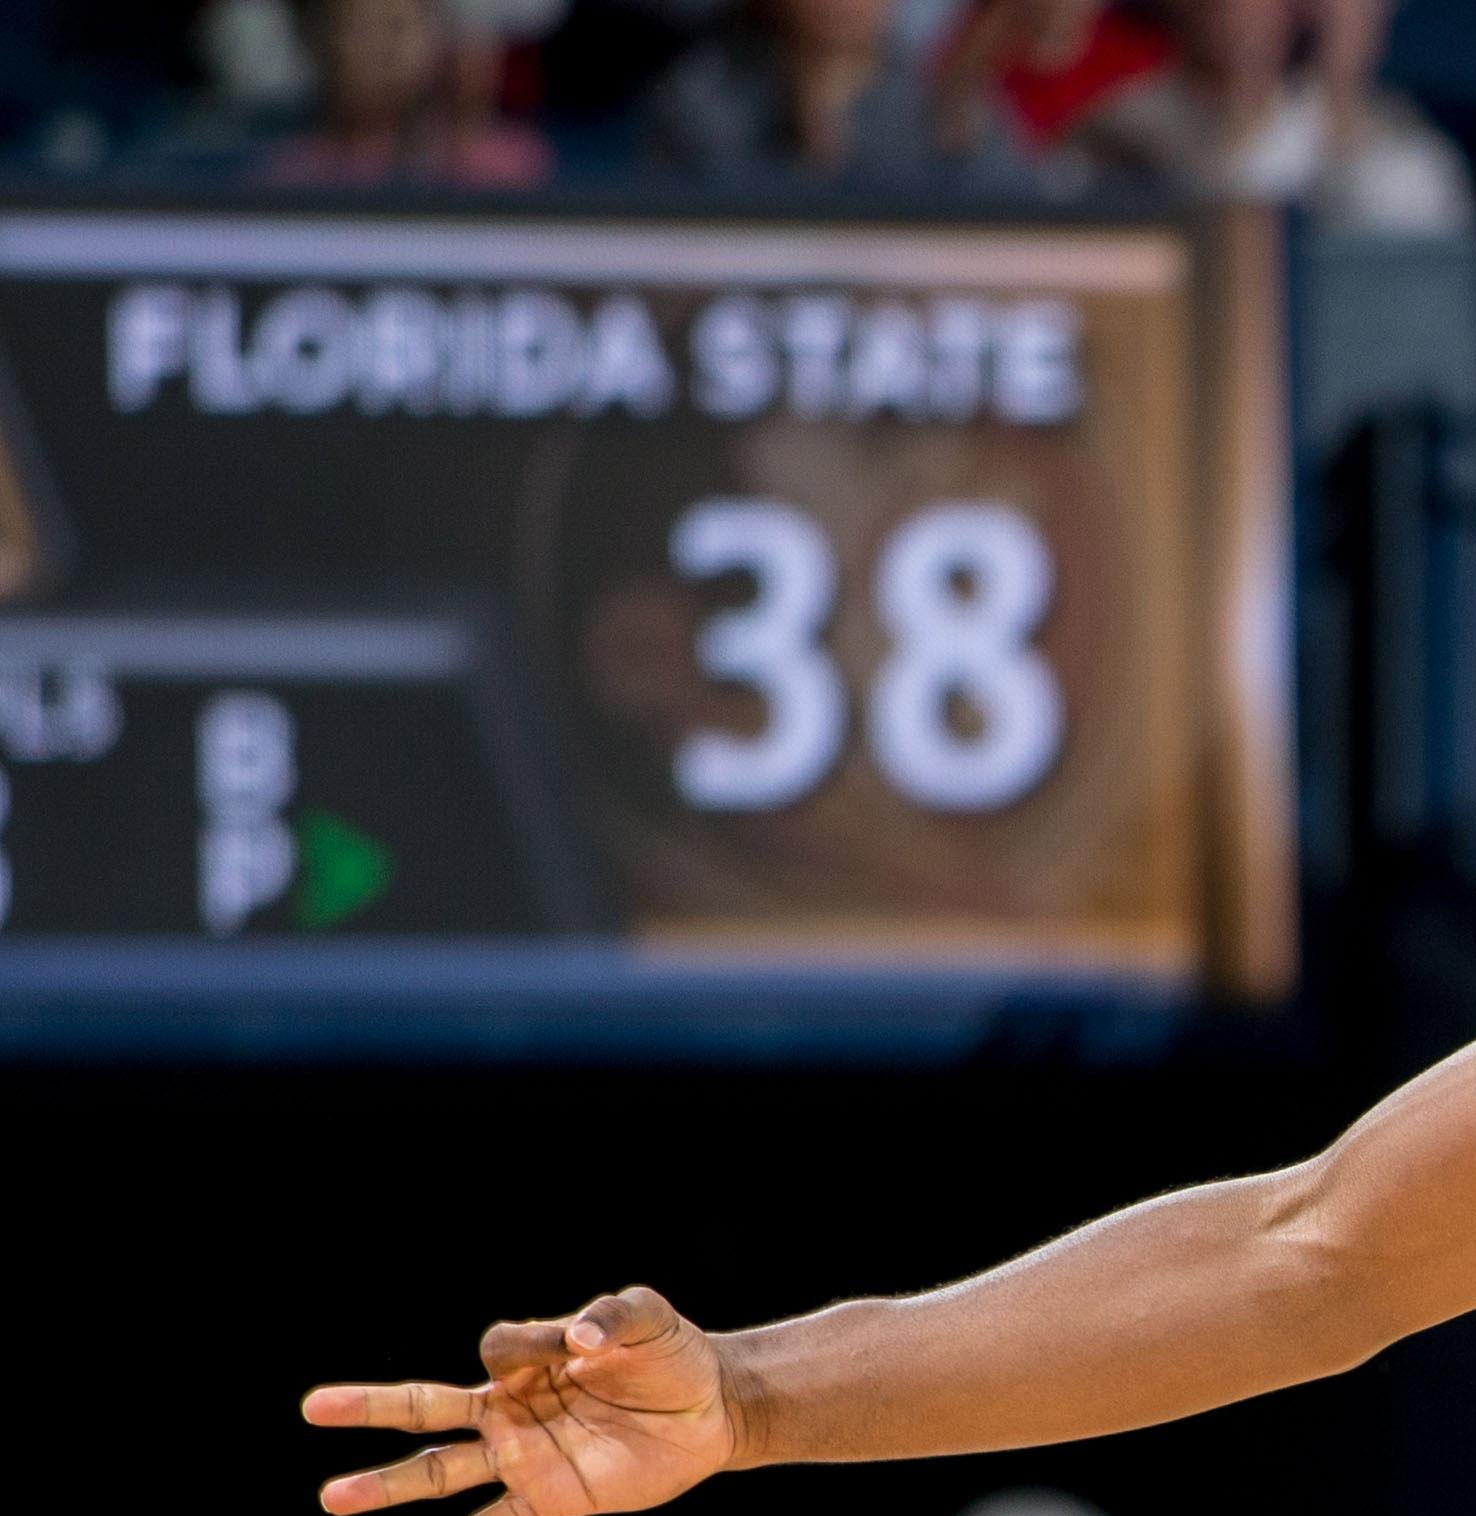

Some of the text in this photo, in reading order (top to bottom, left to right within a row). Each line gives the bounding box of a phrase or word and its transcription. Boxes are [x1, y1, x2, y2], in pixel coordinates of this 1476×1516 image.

[108, 283, 1082, 424] FLORIDA STATE
[668, 495, 1065, 812] 38
